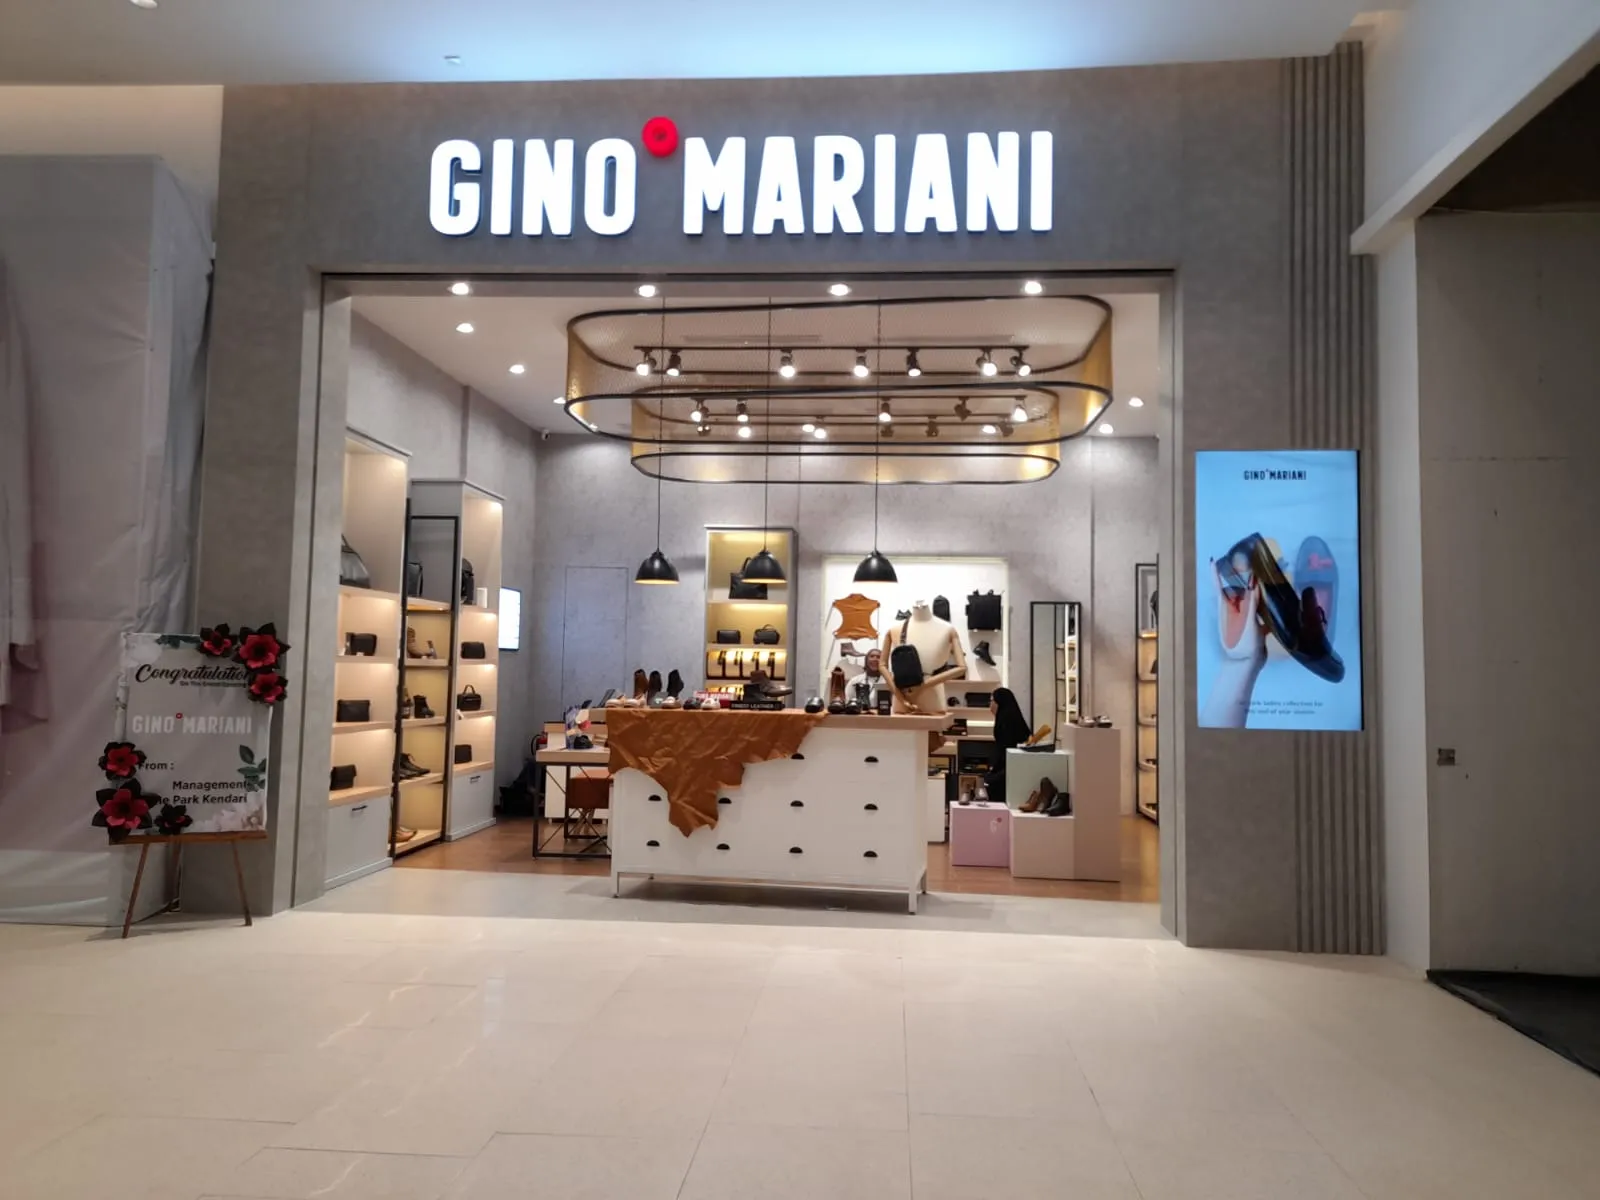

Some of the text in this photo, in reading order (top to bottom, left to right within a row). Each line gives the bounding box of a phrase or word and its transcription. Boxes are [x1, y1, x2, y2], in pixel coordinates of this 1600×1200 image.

[429, 130, 1054, 236] GINO MARIANI
[1244, 470, 1307, 481] GINO MARIANI
[132, 715, 252, 734] GINO MARIANI
[138, 761, 168, 771] From
[172, 794, 199, 804] Park
[202, 794, 247, 804] Kendari
